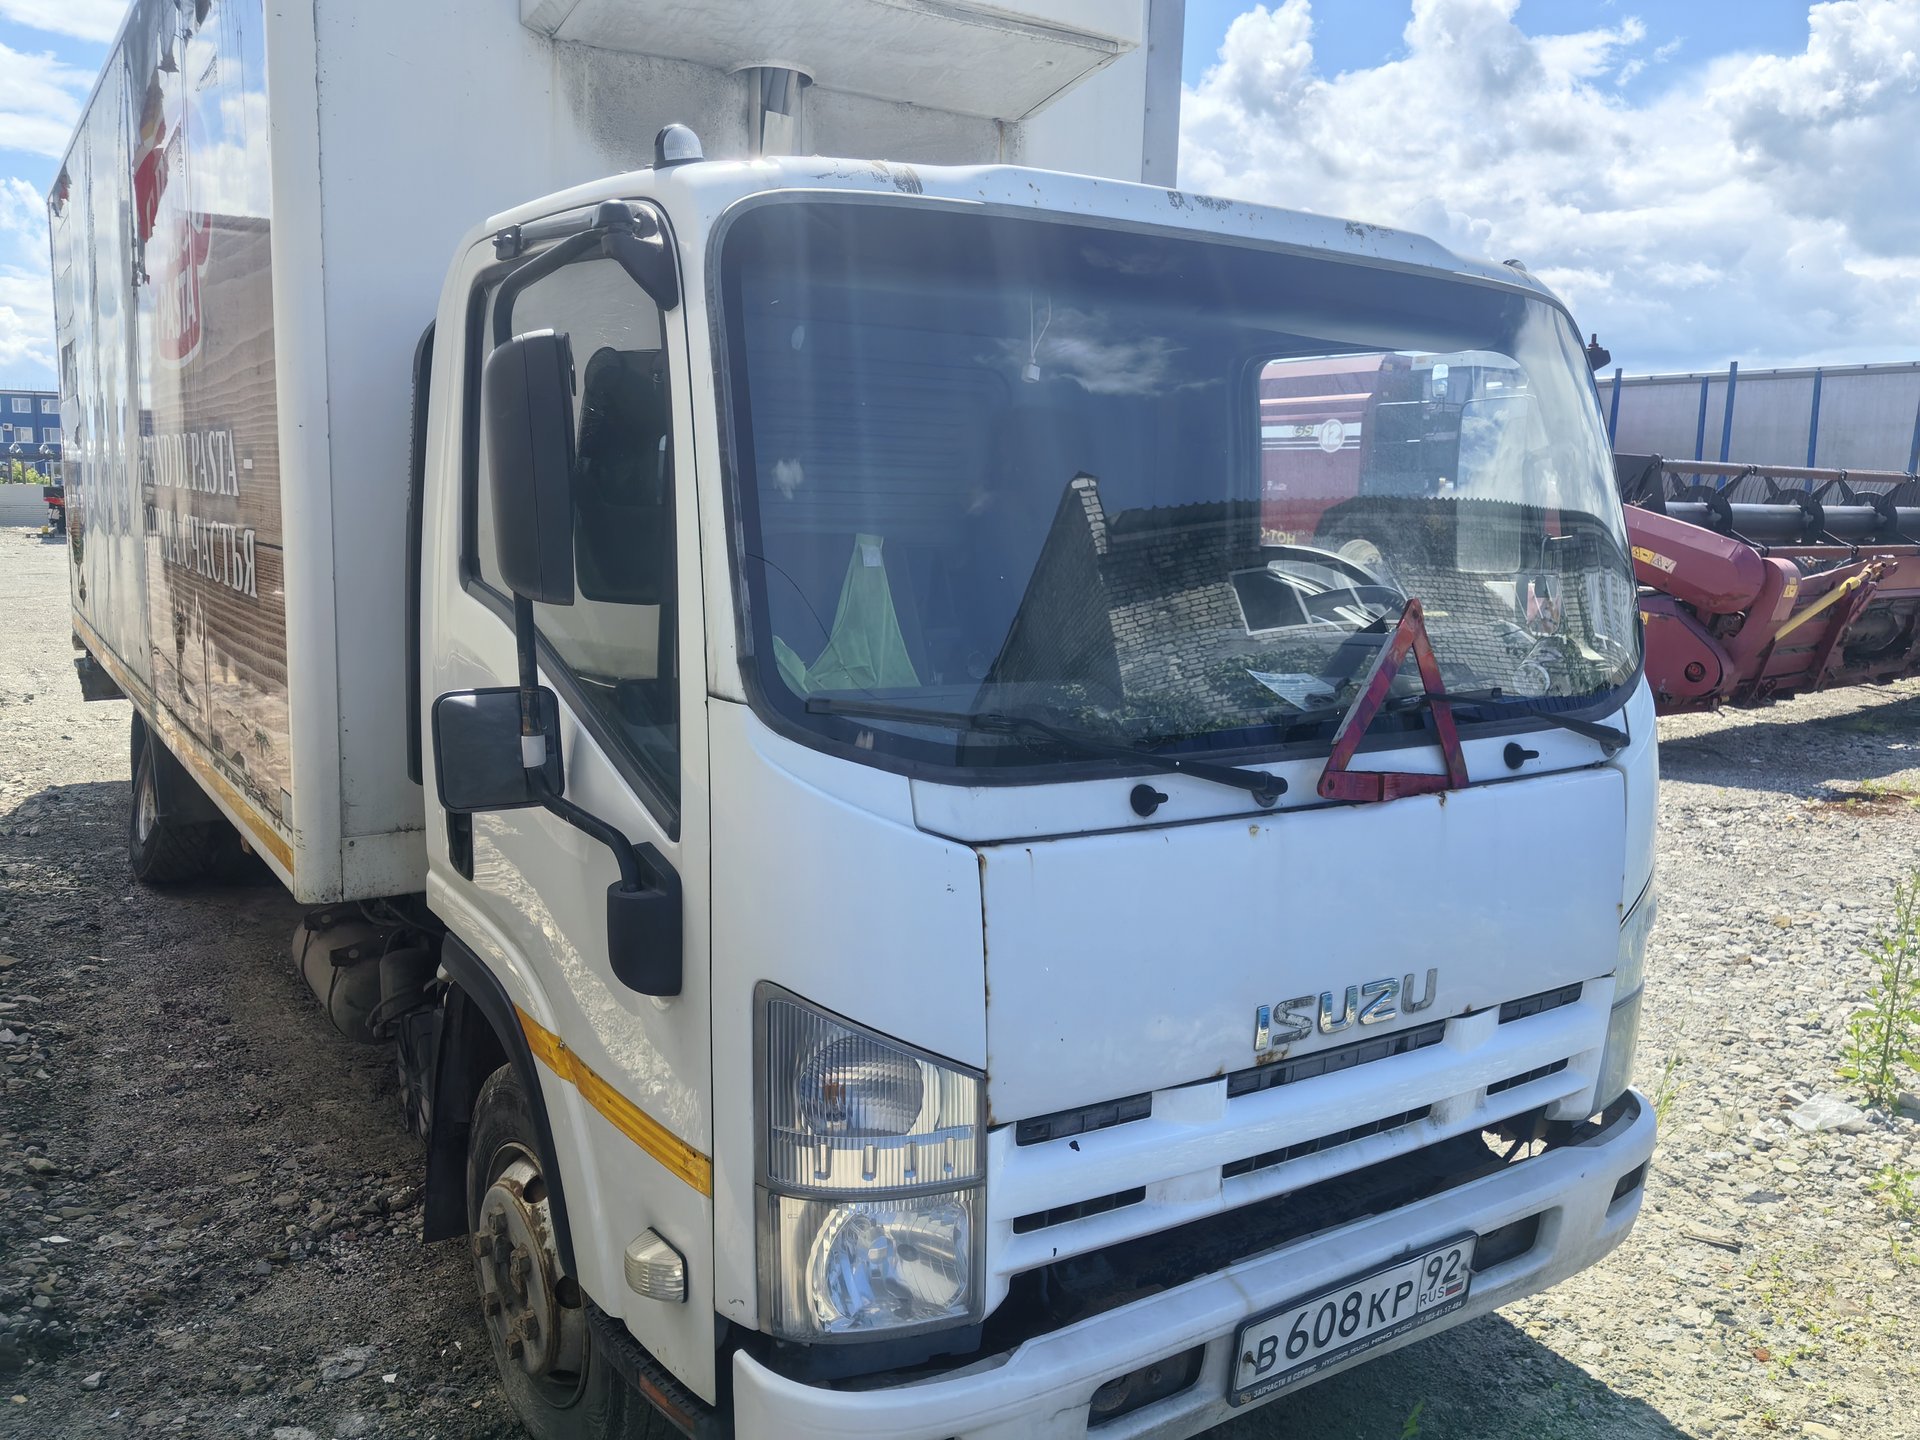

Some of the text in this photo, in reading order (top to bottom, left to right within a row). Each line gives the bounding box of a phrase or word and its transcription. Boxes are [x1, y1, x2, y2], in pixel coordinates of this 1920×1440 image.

[1293, 424, 1314, 437] GS
[1322, 422, 1341, 446] 12
[174, 433, 189, 489] DI
[190, 429, 240, 497] PASTA
[182, 513, 258, 599] СЧАСТЬЯ
[1254, 968, 1438, 1051] ISUZU
[1427, 1249, 1461, 1290] 92
[1419, 1286, 1445, 1307] RUS
